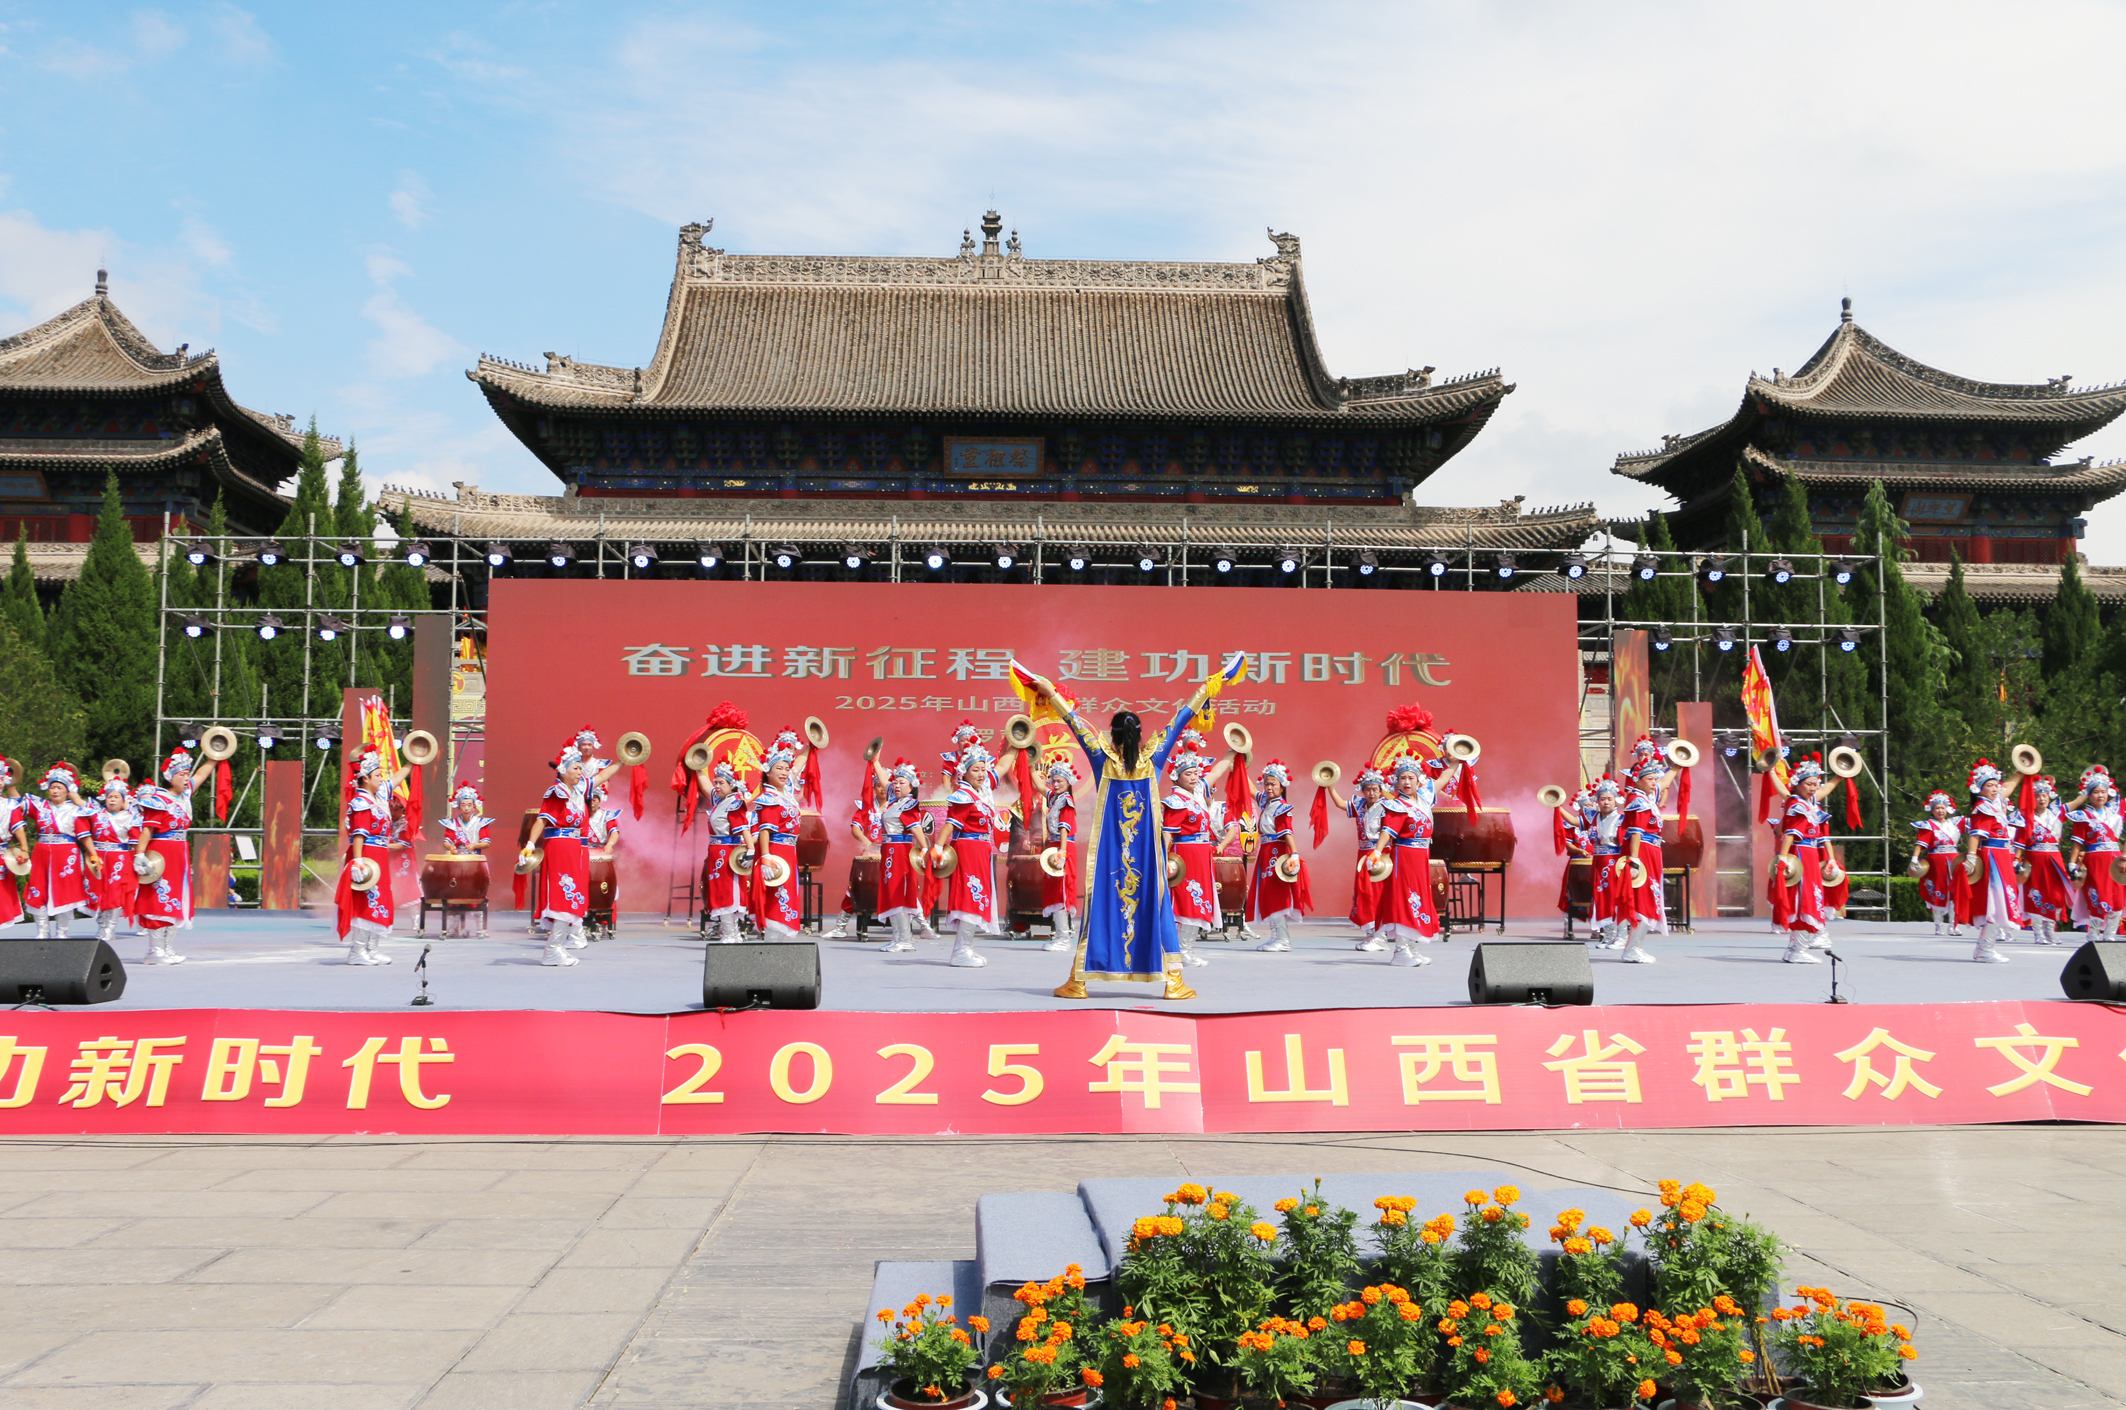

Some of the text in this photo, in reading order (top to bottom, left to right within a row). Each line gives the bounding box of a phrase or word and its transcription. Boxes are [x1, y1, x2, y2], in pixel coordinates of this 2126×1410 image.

[620, 643, 1452, 687] 奋进新征程 建功新时代
[835, 695, 1277, 716] 2025年山西群众文活动
[661, 1022, 2126, 1110] 2025年山西省群众文
